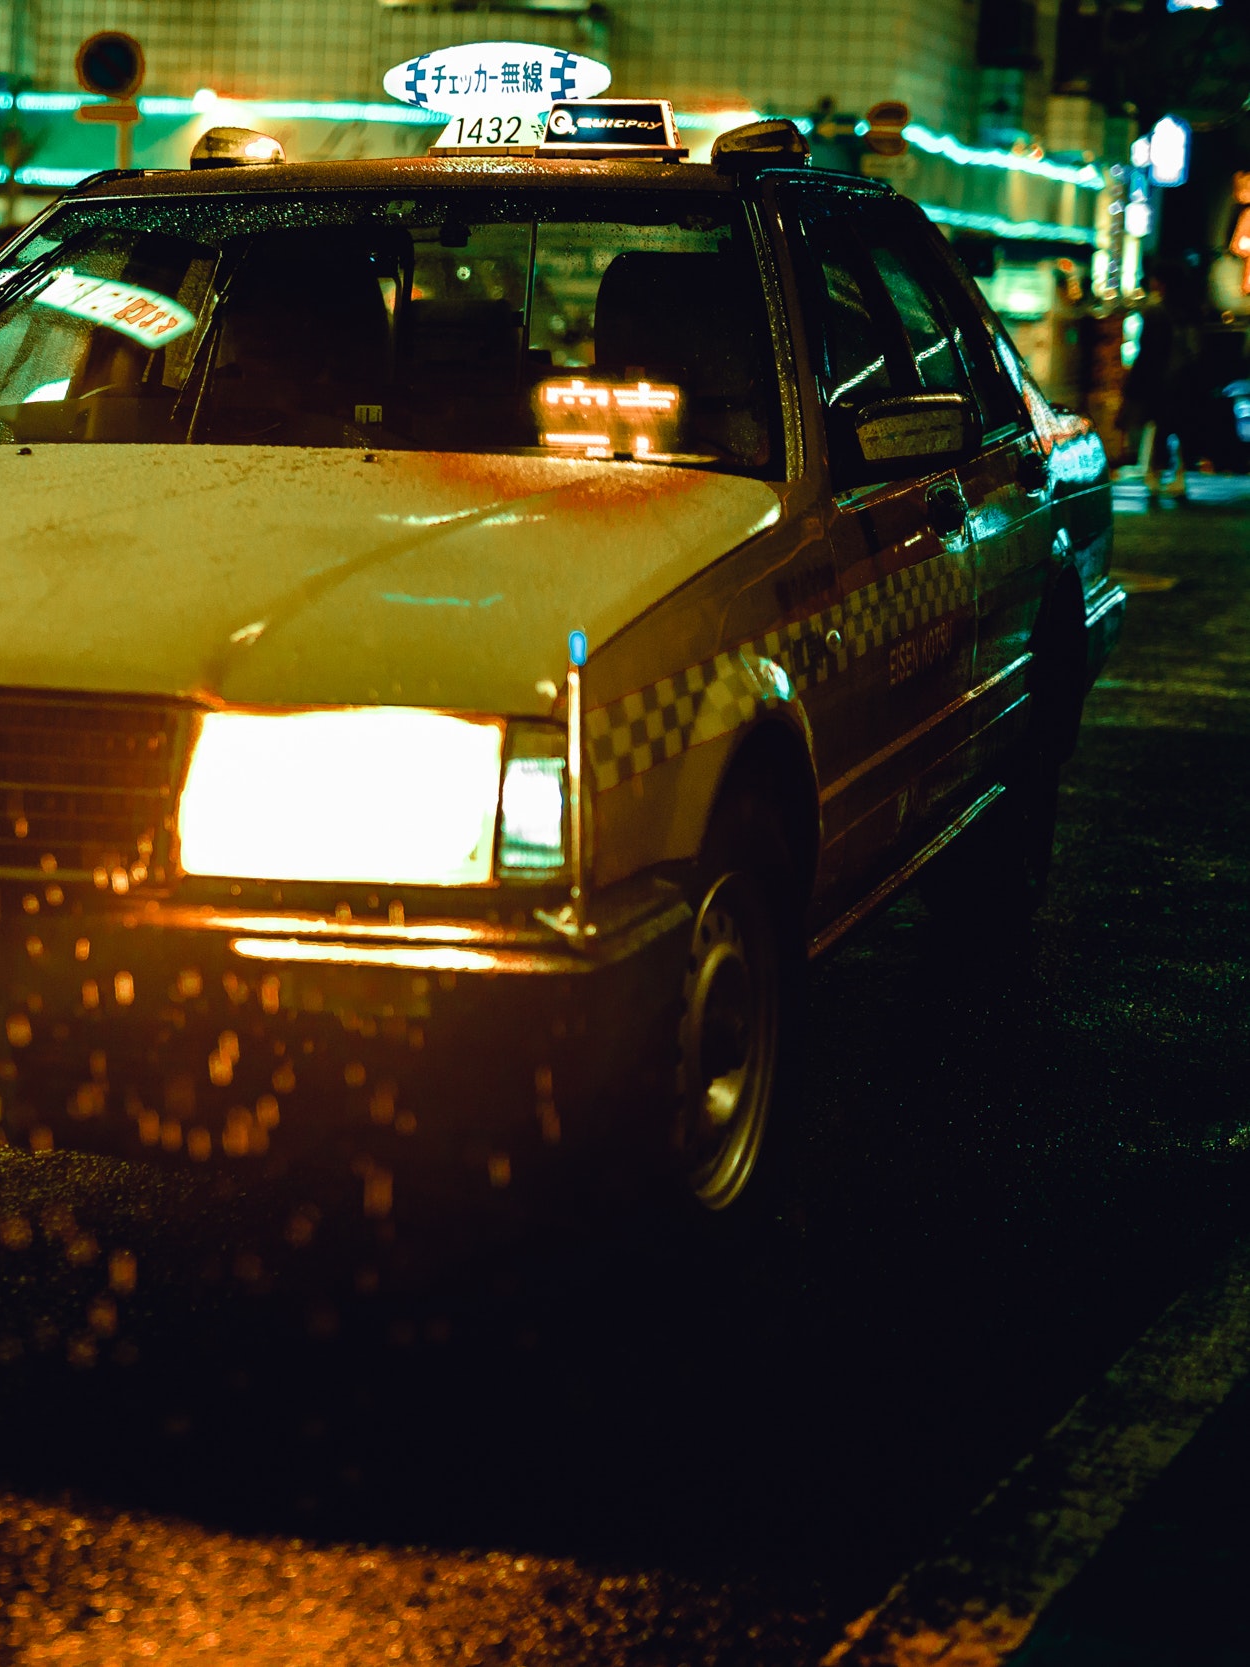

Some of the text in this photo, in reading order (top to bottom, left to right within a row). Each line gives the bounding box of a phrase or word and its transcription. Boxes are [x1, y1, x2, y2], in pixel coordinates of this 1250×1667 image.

[431, 59, 544, 95] チェッカー無線
[456, 116, 522, 144] 1432
[888, 640, 919, 687] EISEN
